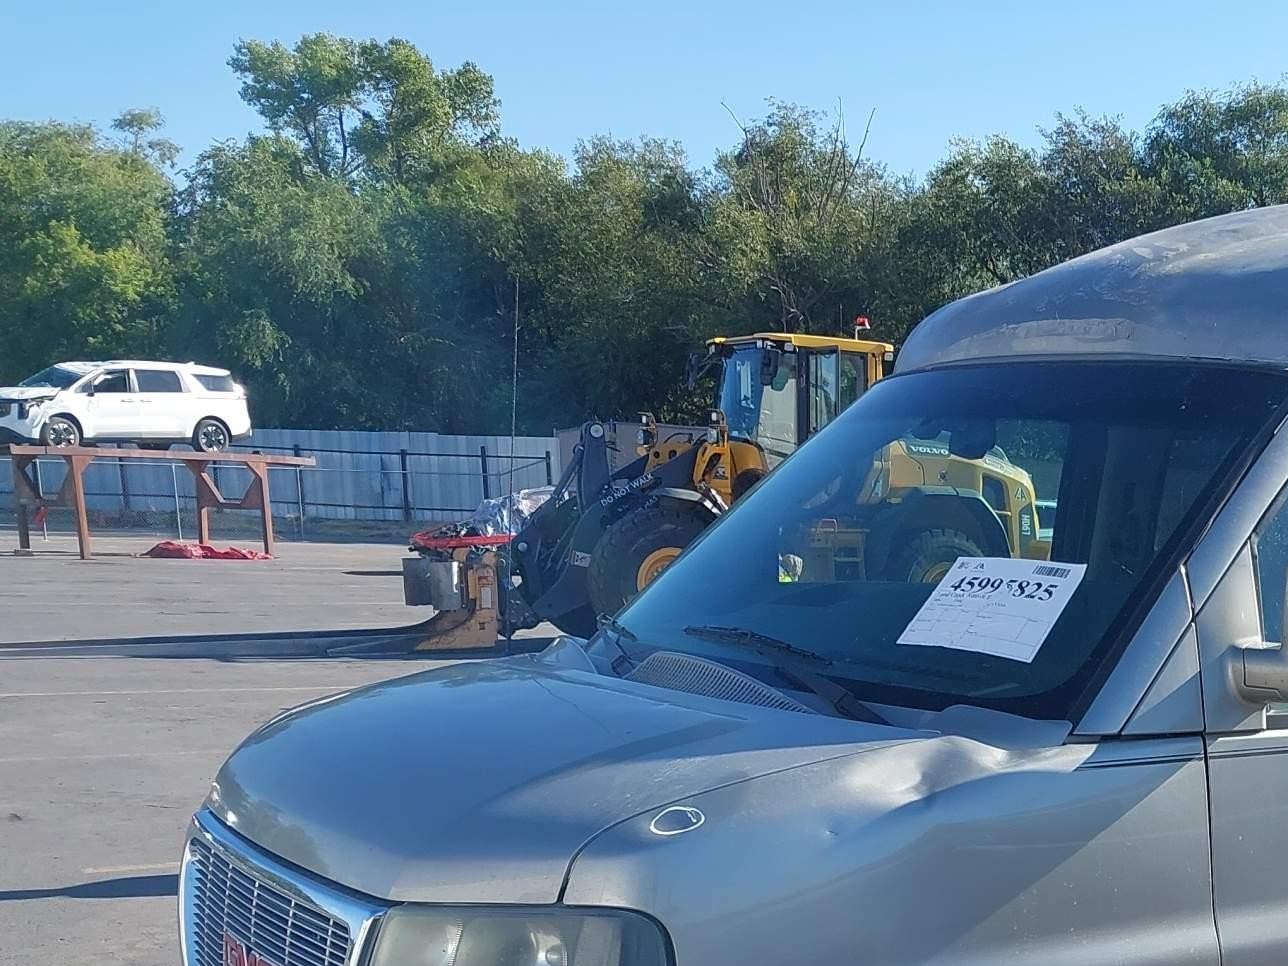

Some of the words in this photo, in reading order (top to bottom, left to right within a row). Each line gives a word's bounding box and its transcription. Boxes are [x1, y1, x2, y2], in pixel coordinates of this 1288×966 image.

[909, 445, 949, 455] VOLVO
[600, 495, 614, 506] DO
[614, 485, 630, 499] NOT
[630, 473, 655, 489] WALK
[950, 575, 1059, 602] 45995825
